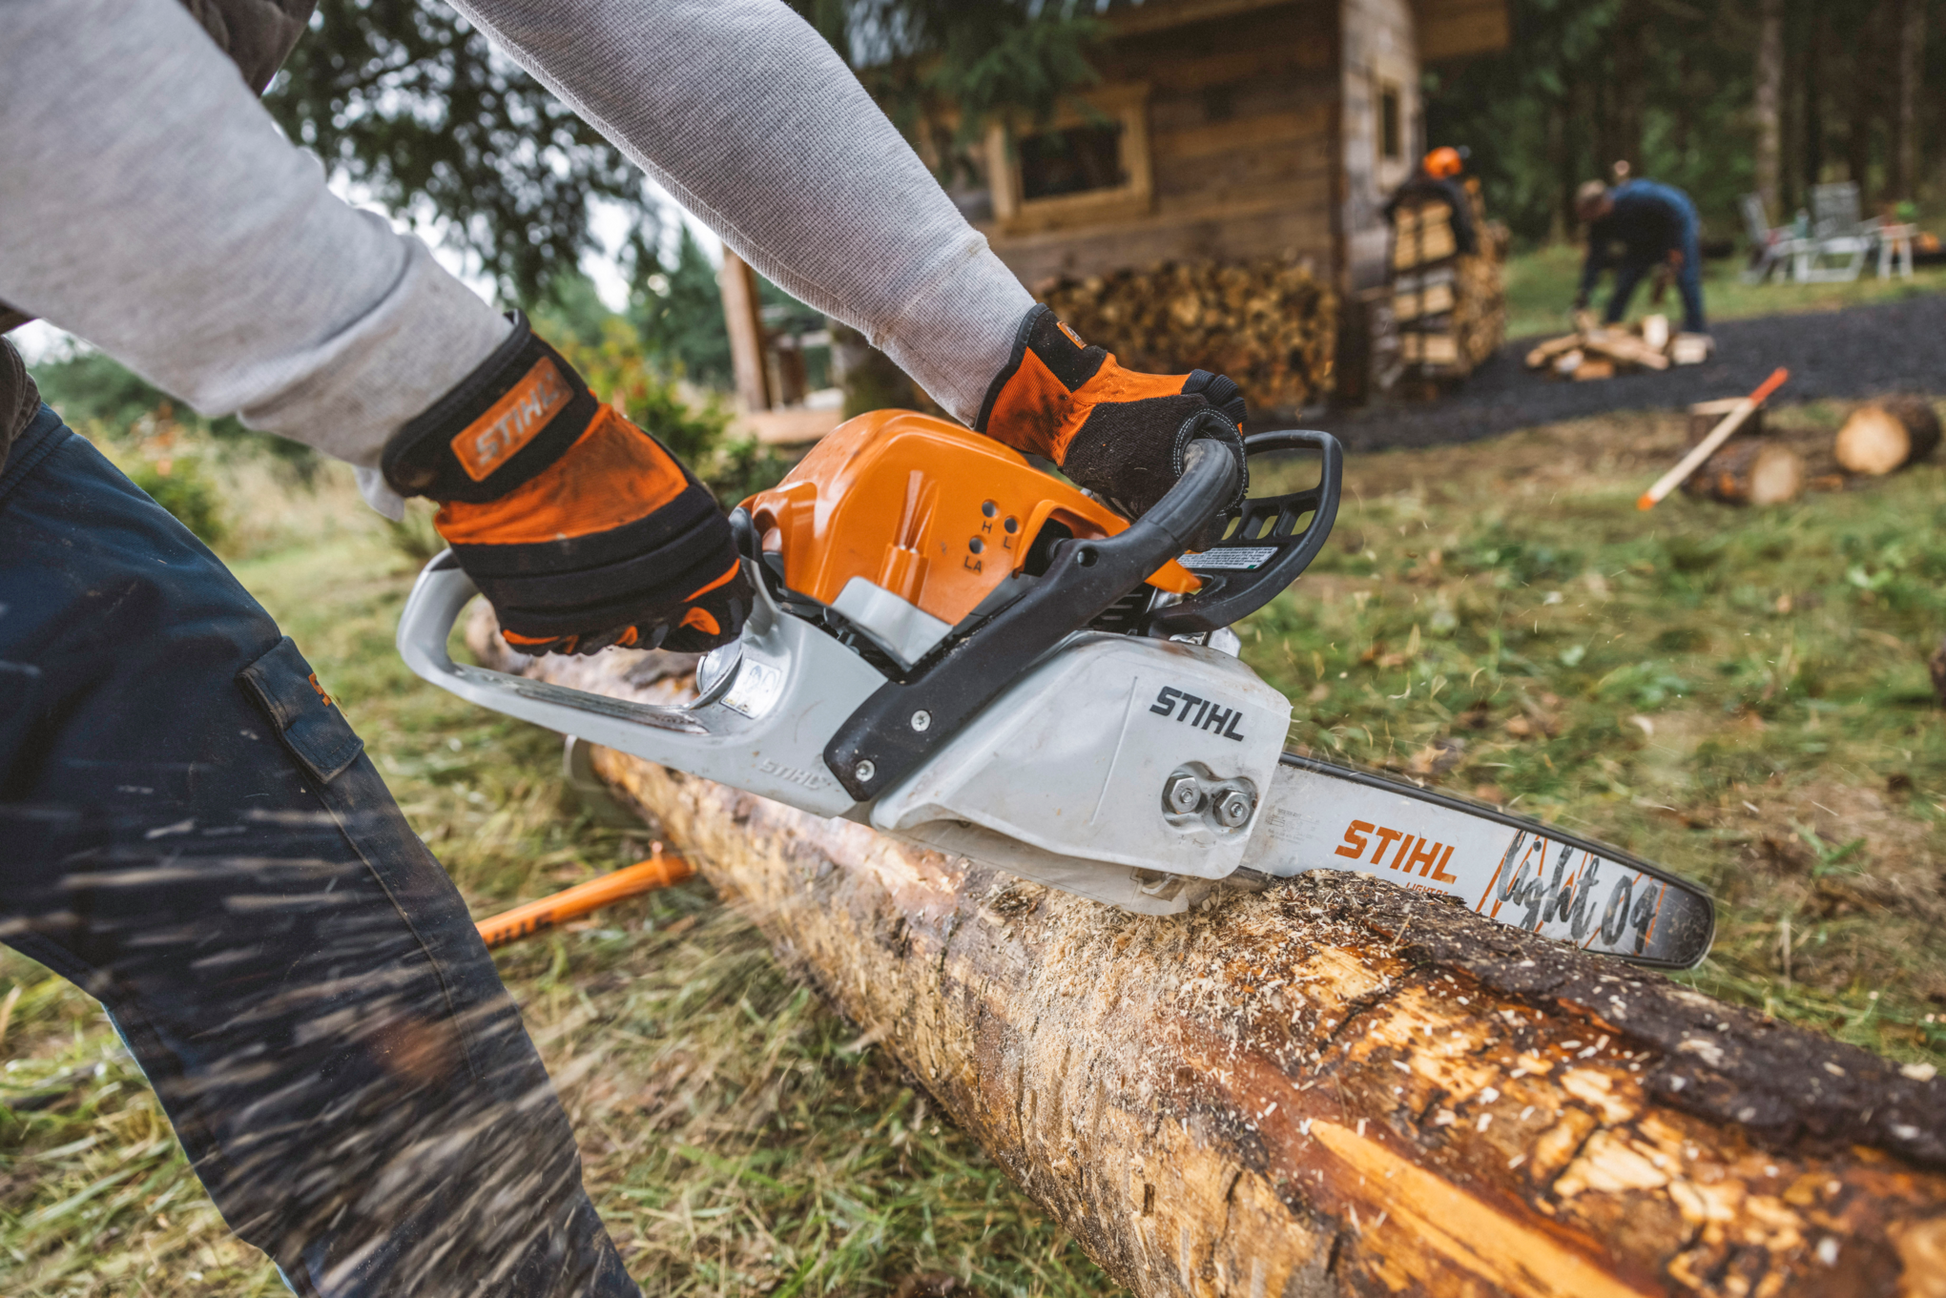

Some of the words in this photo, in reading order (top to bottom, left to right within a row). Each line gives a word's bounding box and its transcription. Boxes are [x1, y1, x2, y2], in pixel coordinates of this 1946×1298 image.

[475, 381, 559, 466] STIHL
[981, 520, 993, 534] H
[1003, 535, 1012, 550] L
[964, 555, 982, 573] LA
[1149, 685, 1245, 742] STIHL
[1334, 819, 1458, 885] STIHL
[1601, 875, 1658, 954] 04
